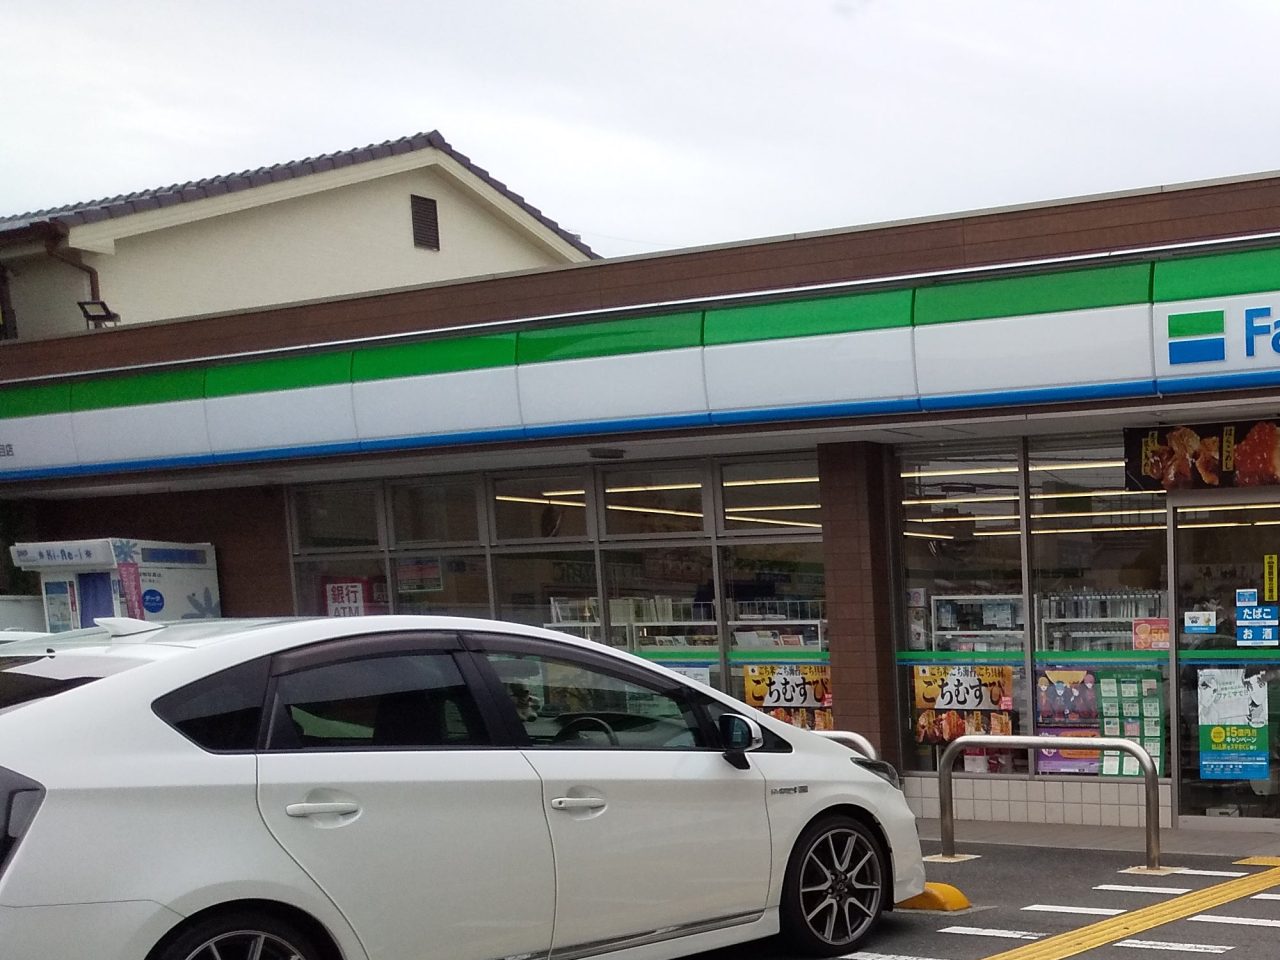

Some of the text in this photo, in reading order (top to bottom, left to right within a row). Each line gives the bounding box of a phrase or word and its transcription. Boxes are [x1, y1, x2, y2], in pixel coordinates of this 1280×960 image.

[330, 584, 358, 604] 銀行
[333, 606, 359, 617] ATM
[1242, 607, 1272, 620] たばこ
[1242, 628, 1273, 640] お酒
[751, 676, 830, 705] ごちむすび
[922, 677, 1006, 707] ごちむすび
